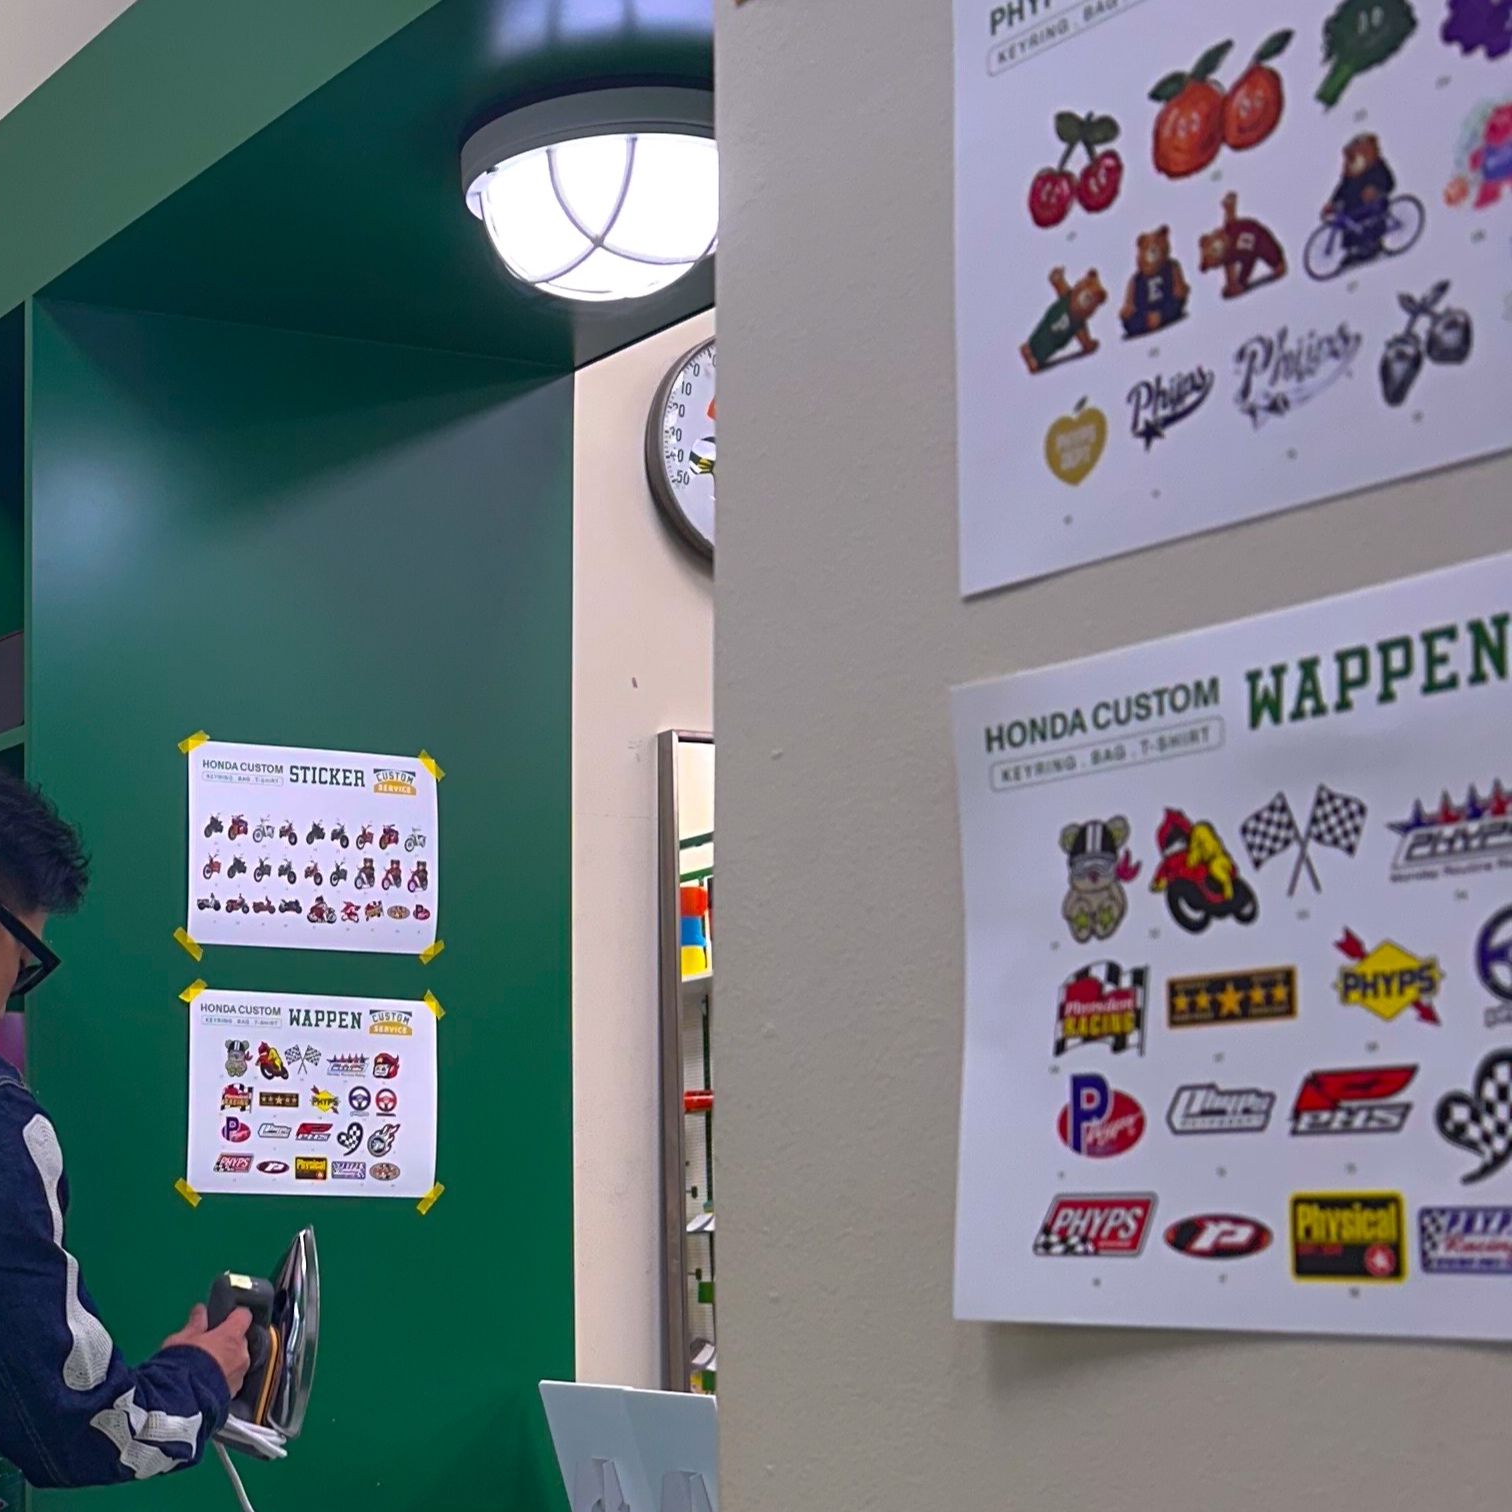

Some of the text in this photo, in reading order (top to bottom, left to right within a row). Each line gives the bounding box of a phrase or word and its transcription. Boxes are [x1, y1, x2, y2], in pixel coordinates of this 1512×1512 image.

[997, 18, 1069, 63] KEYRING
[681, 381, 692, 396] 10
[676, 470, 690, 485] 50
[985, 612, 1512, 752] HONDA CUSTOM WAPPEN
[1001, 725, 1210, 784] KEYRING BAG T-SHIRT
[203, 759, 365, 787] HONDA CUSTOM STICKER
[376, 771, 413, 785] CUSTOM
[378, 784, 411, 794] SERVICE
[1340, 963, 1437, 997] PHYPS
[201, 1003, 362, 1029] HONDA CUSTOM WAPPEN
[372, 1012, 409, 1025] CUSTOM
[374, 1025, 407, 1034] SERVICE
[1053, 1207, 1145, 1239] PHYPS
[1296, 1203, 1397, 1242] Physical
